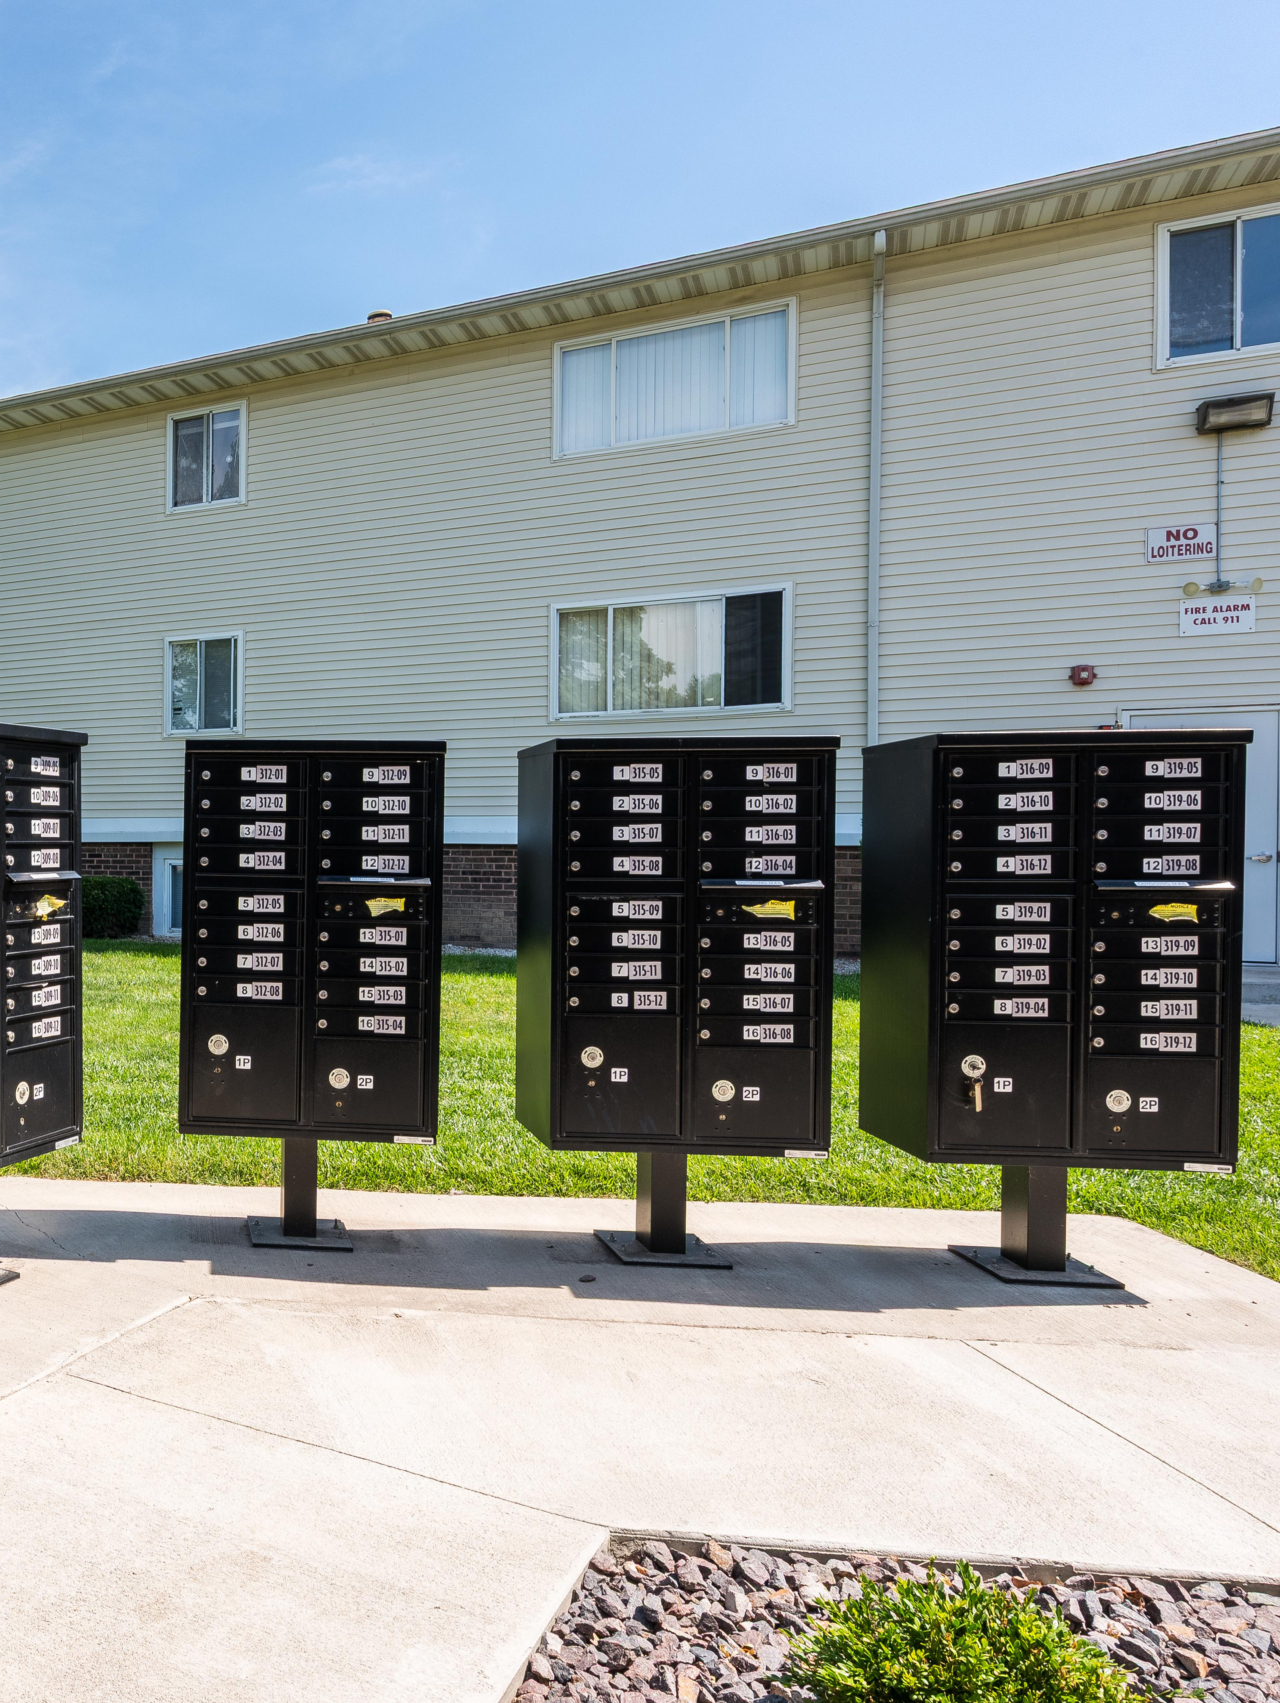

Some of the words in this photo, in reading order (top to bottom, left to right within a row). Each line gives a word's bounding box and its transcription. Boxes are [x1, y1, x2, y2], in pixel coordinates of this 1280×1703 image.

[1166, 527, 1198, 542] NO
[1151, 541, 1213, 558] LOITERING
[1184, 606, 1207, 615] FIRE
[1212, 603, 1251, 613] ALARM
[1193, 617, 1218, 625] CALL
[1222, 615, 1240, 624] 911
[246, 769, 252, 779] 1
[259, 767, 284, 780] 312-01
[367, 770, 375, 780] 9
[381, 768, 408, 781] 312-09
[619, 768, 625, 778] 1
[631, 766, 660, 780] 315-05
[1005, 764, 1011, 775] 1
[1018, 761, 1051, 776] 316-09
[1150, 763, 1159, 774] 9
[1166, 761, 1199, 775] 319-05
[32, 791, 40, 801] 10
[245, 798, 252, 808] 2
[258, 796, 284, 809] 312-02
[1003, 796, 1012, 807] 2
[1019, 794, 1050, 809] 316-10
[364, 799, 377, 809] 10
[381, 799, 407, 811] 312-10
[747, 798, 761, 809] 10
[765, 797, 794, 811] 316-02
[617, 828, 625, 839] 3
[631, 826, 659, 840] 315-07
[747, 829, 761, 839] 11
[764, 828, 794, 842] 316-03
[1147, 827, 1161, 838] 11
[1165, 826, 1198, 840] 319-07
[243, 855, 251, 866] 4
[256, 854, 283, 867] 312-04
[1001, 859, 1010, 870] 4
[1018, 858, 1048, 872] 316-12
[242, 898, 250, 909] 5
[256, 897, 282, 910] 312-05
[361, 930, 375, 941] 13
[378, 929, 404, 943] 315-01
[616, 934, 624, 945] 6
[631, 933, 658, 946] 315-10
[745, 936, 760, 946] 13
[762, 934, 792, 948] 316-05
[1000, 938, 1009, 949] 6
[1016, 937, 1047, 951] 319-02
[1143, 939, 1159, 950] 13
[1163, 939, 1196, 953] 319-09
[33, 961, 41, 972] 14
[241, 956, 248, 966] 7
[255, 955, 280, 968] 312-07
[746, 966, 760, 977] 14
[763, 966, 793, 980] 316-06
[1142, 971, 1159, 983] 14
[1163, 971, 1194, 985] 319-10
[360, 989, 374, 999] 15
[376, 989, 404, 1002] 315-03
[616, 994, 624, 1005] 8
[637, 994, 663, 1007] 315-12
[999, 1001, 1007, 1012] 8
[1014, 1001, 1046, 1014] 319-04
[745, 1028, 759, 1038] 16
[762, 1027, 792, 1040] 316-08
[1142, 1035, 1158, 1046] 16
[1163, 1035, 1193, 1049] 319-12
[236, 1057, 251, 1067] 1P
[612, 1070, 627, 1080] 1P
[358, 1077, 373, 1087] 2P
[995, 1080, 1011, 1090] 1P
[34, 1086, 43, 1097] 2P
[743, 1089, 759, 1099] 2P
[1140, 1099, 1158, 1110] 2P
